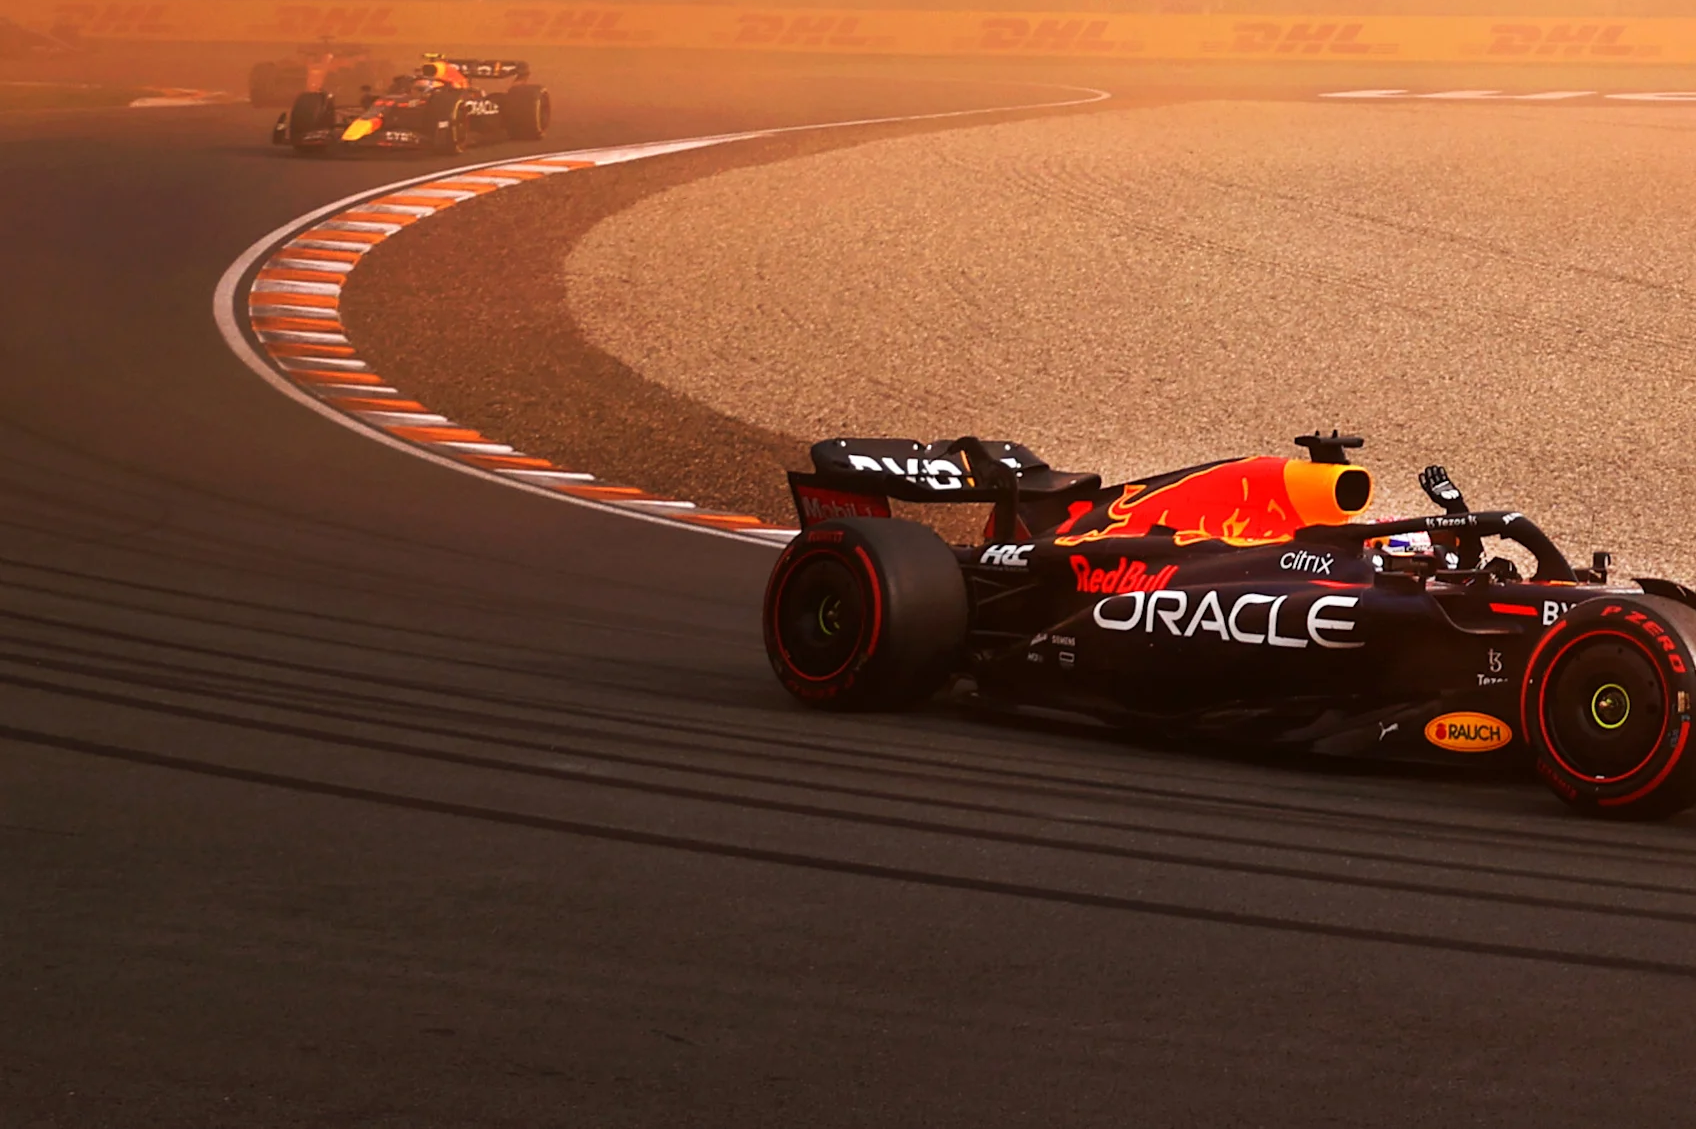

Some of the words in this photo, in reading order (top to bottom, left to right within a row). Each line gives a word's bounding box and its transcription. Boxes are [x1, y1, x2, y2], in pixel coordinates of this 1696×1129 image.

[274, 5, 397, 35] DHL
[734, 14, 868, 46] DHL
[979, 19, 1116, 51] DHL
[1228, 22, 1373, 55] DHL
[1486, 24, 1634, 56] DHL
[801, 496, 858, 519] Mobil
[1436, 517, 1468, 528] Tezos
[980, 544, 1036, 566] HRC
[1279, 550, 1334, 575] citrix
[1093, 590, 1365, 649] ORACLE
[1624, 611, 1688, 674] ZERO
[1448, 724, 1501, 742] RAUCH
